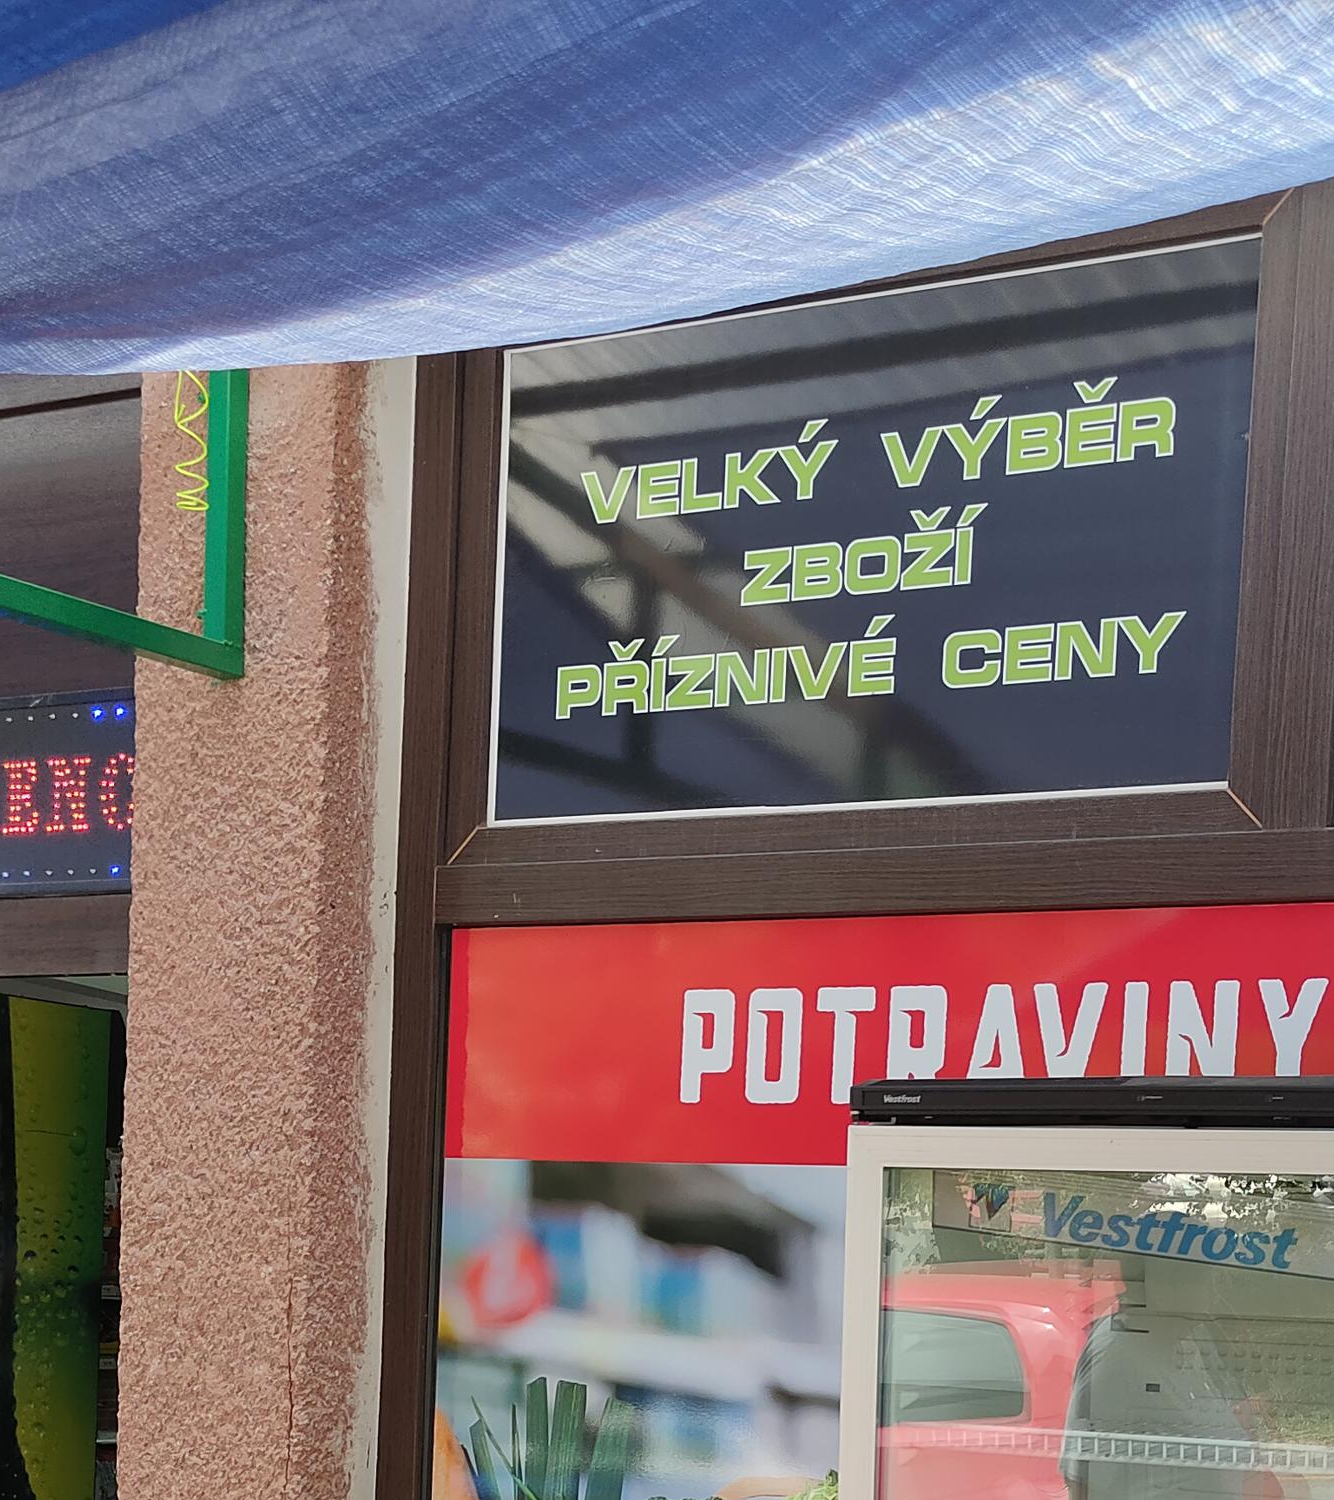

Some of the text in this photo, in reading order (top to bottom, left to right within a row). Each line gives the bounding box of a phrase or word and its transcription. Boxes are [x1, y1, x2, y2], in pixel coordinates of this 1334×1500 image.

[580, 376, 1176, 525] VELKÝ VÝBĚR
[739, 502, 988, 606] ZBOŽÍ
[554, 610, 1188, 721] PŘÍZNIVÉ CENY
[678, 975, 1331, 1106] POTRAVINY
[882, 1093, 922, 1105] Vestfrost
[1042, 1192, 1299, 1270] Vestfrost
